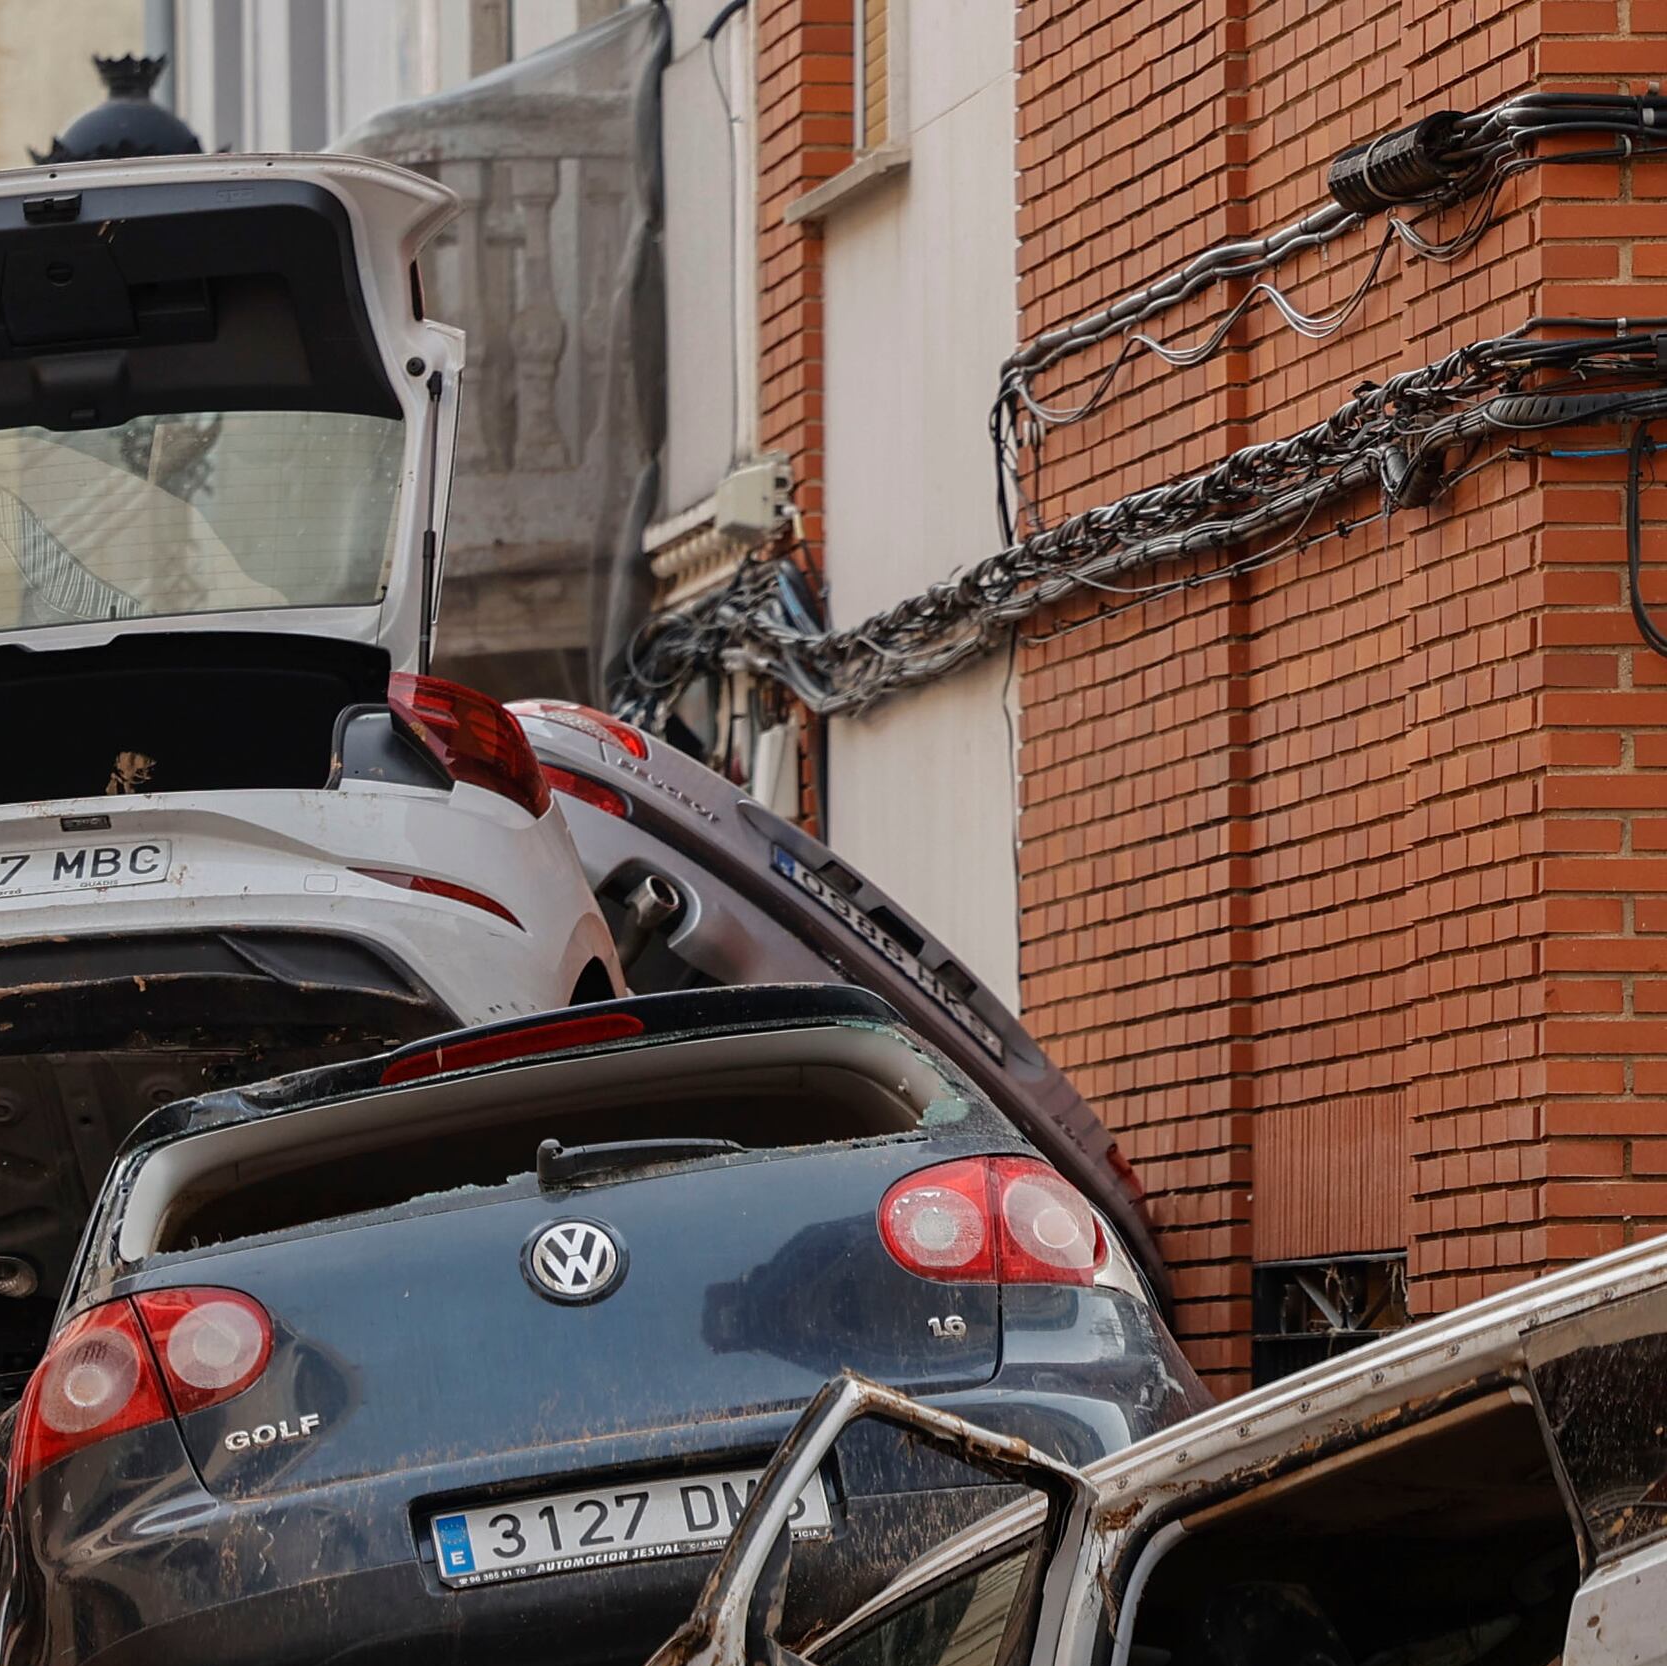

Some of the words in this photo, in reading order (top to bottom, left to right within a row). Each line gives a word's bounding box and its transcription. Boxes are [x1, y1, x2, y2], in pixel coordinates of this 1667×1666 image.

[53, 845, 161, 882] MBC
[224, 1413, 320, 1451] GOLF
[451, 1551, 466, 1566] E
[487, 1491, 650, 1560] 3127
[537, 1550, 628, 1574] AUTOMOCION
[632, 1543, 680, 1559] JESVAL
